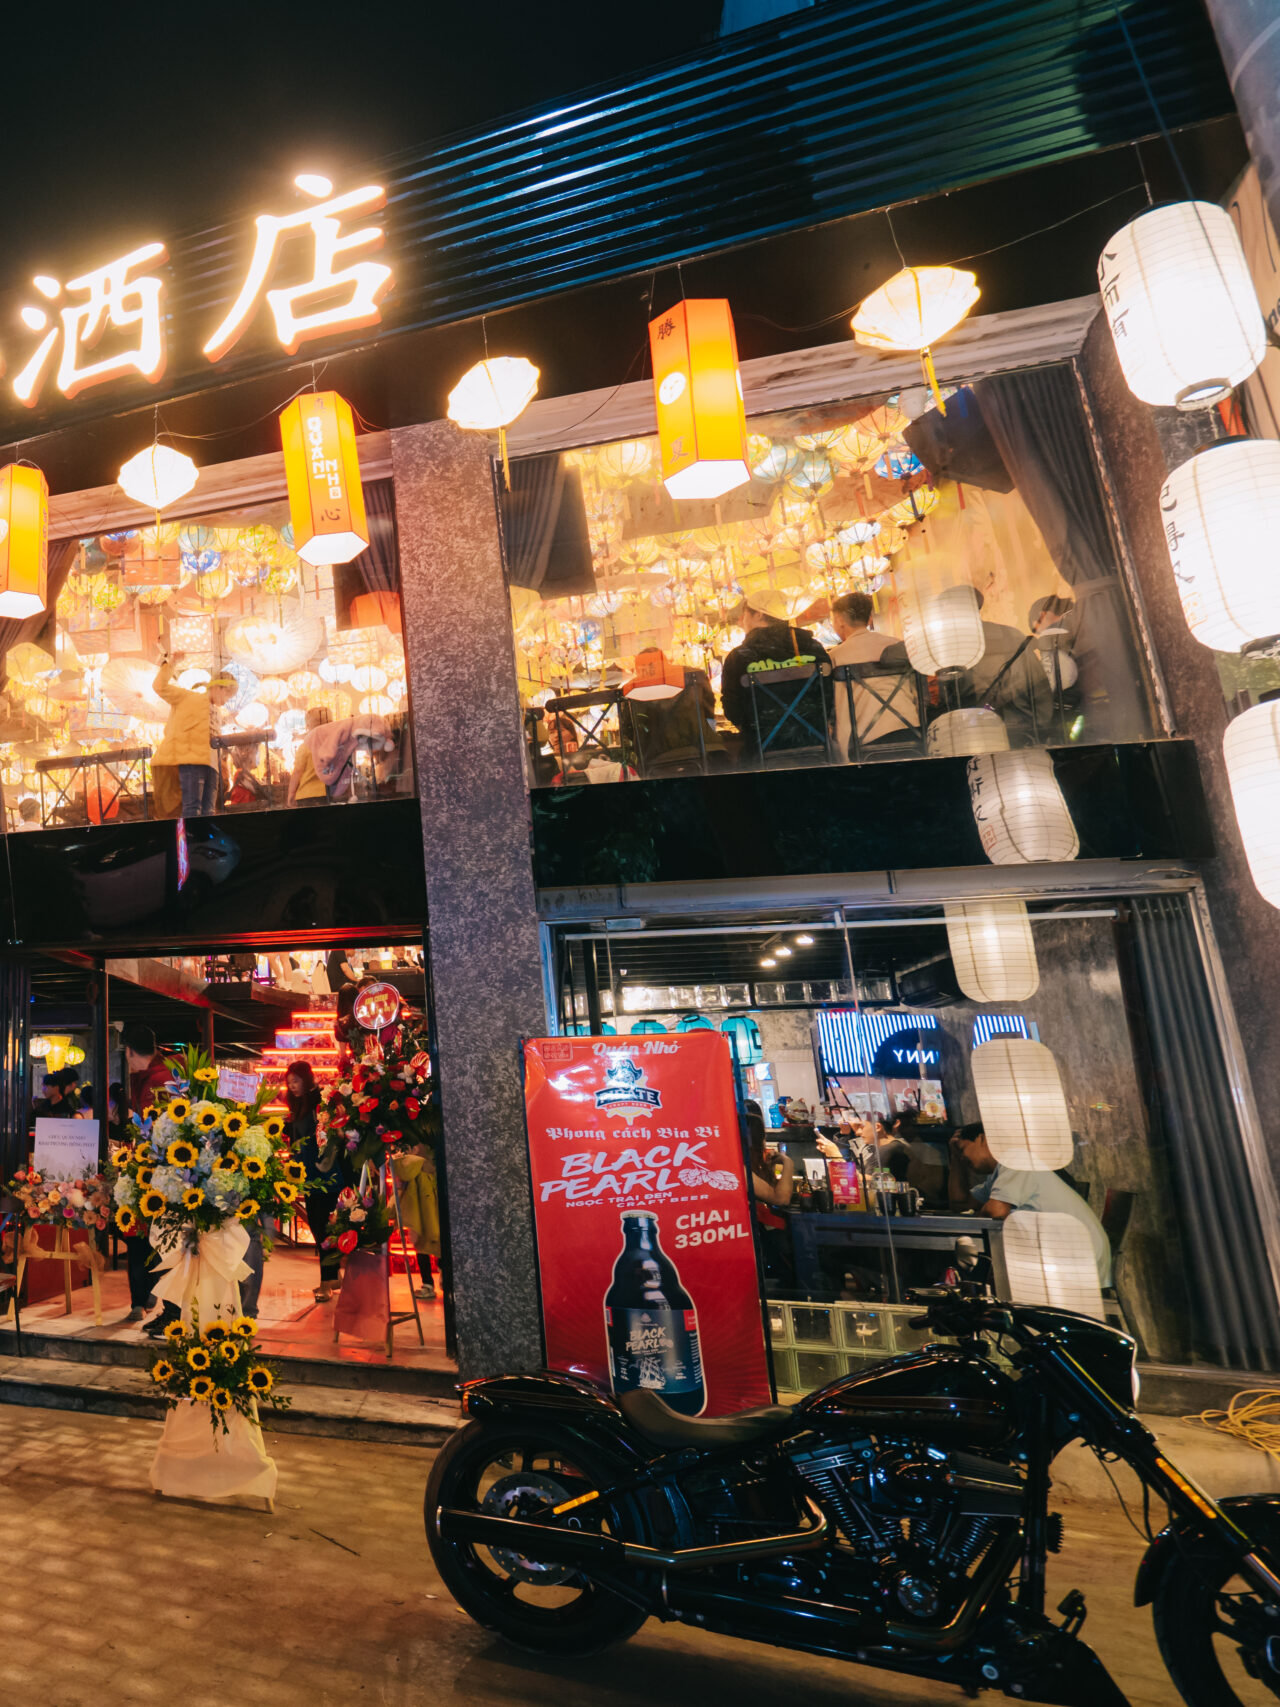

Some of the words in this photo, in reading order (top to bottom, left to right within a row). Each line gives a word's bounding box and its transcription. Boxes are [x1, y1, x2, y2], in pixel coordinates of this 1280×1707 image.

[591, 1042, 639, 1056] Quán
[643, 1040, 682, 1055] Nhỏ
[545, 1127, 606, 1140] Phong
[613, 1127, 652, 1140] cách
[657, 1127, 690, 1139] Bia
[560, 1141, 708, 1178] BLACK
[540, 1168, 681, 1202] PEARL
[608, 1194, 640, 1203] TRAI
[617, 1198, 666, 1208] CRAFT
[670, 1194, 709, 1203] BEER
[675, 1209, 729, 1230] CHAI
[675, 1224, 749, 1249] 330ML
[629, 1327, 666, 1341] BLACK
[626, 1338, 660, 1352] PEARL
